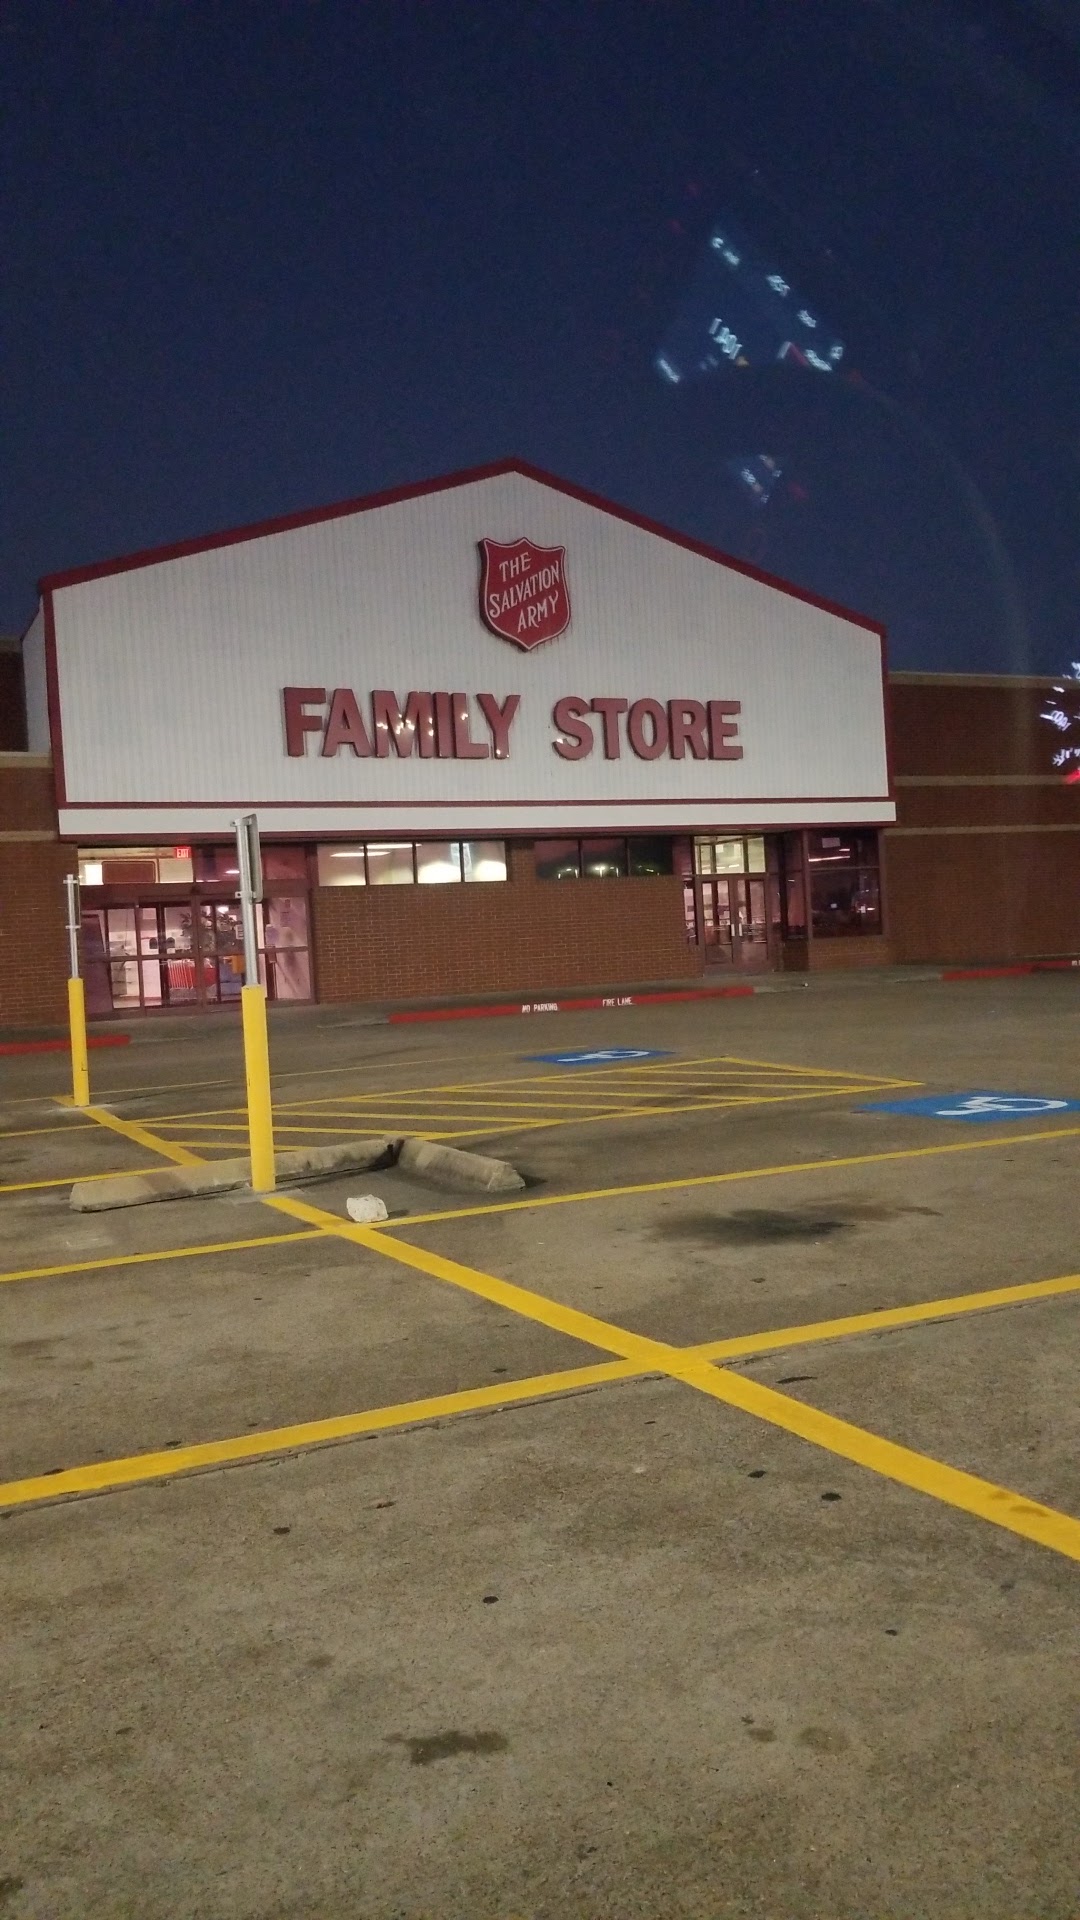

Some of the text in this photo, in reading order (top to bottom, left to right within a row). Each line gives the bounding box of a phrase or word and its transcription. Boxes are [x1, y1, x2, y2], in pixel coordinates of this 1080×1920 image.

[499, 552, 532, 582] THE
[489, 560, 560, 618] SALVATION
[517, 590, 559, 633] ARMY
[282, 686, 744, 761] FAMILY STORE
[176, 848, 189, 858] EXIT
[521, 1003, 558, 1013] NO PARKING
[602, 996, 633, 1007] FIRE LANE
